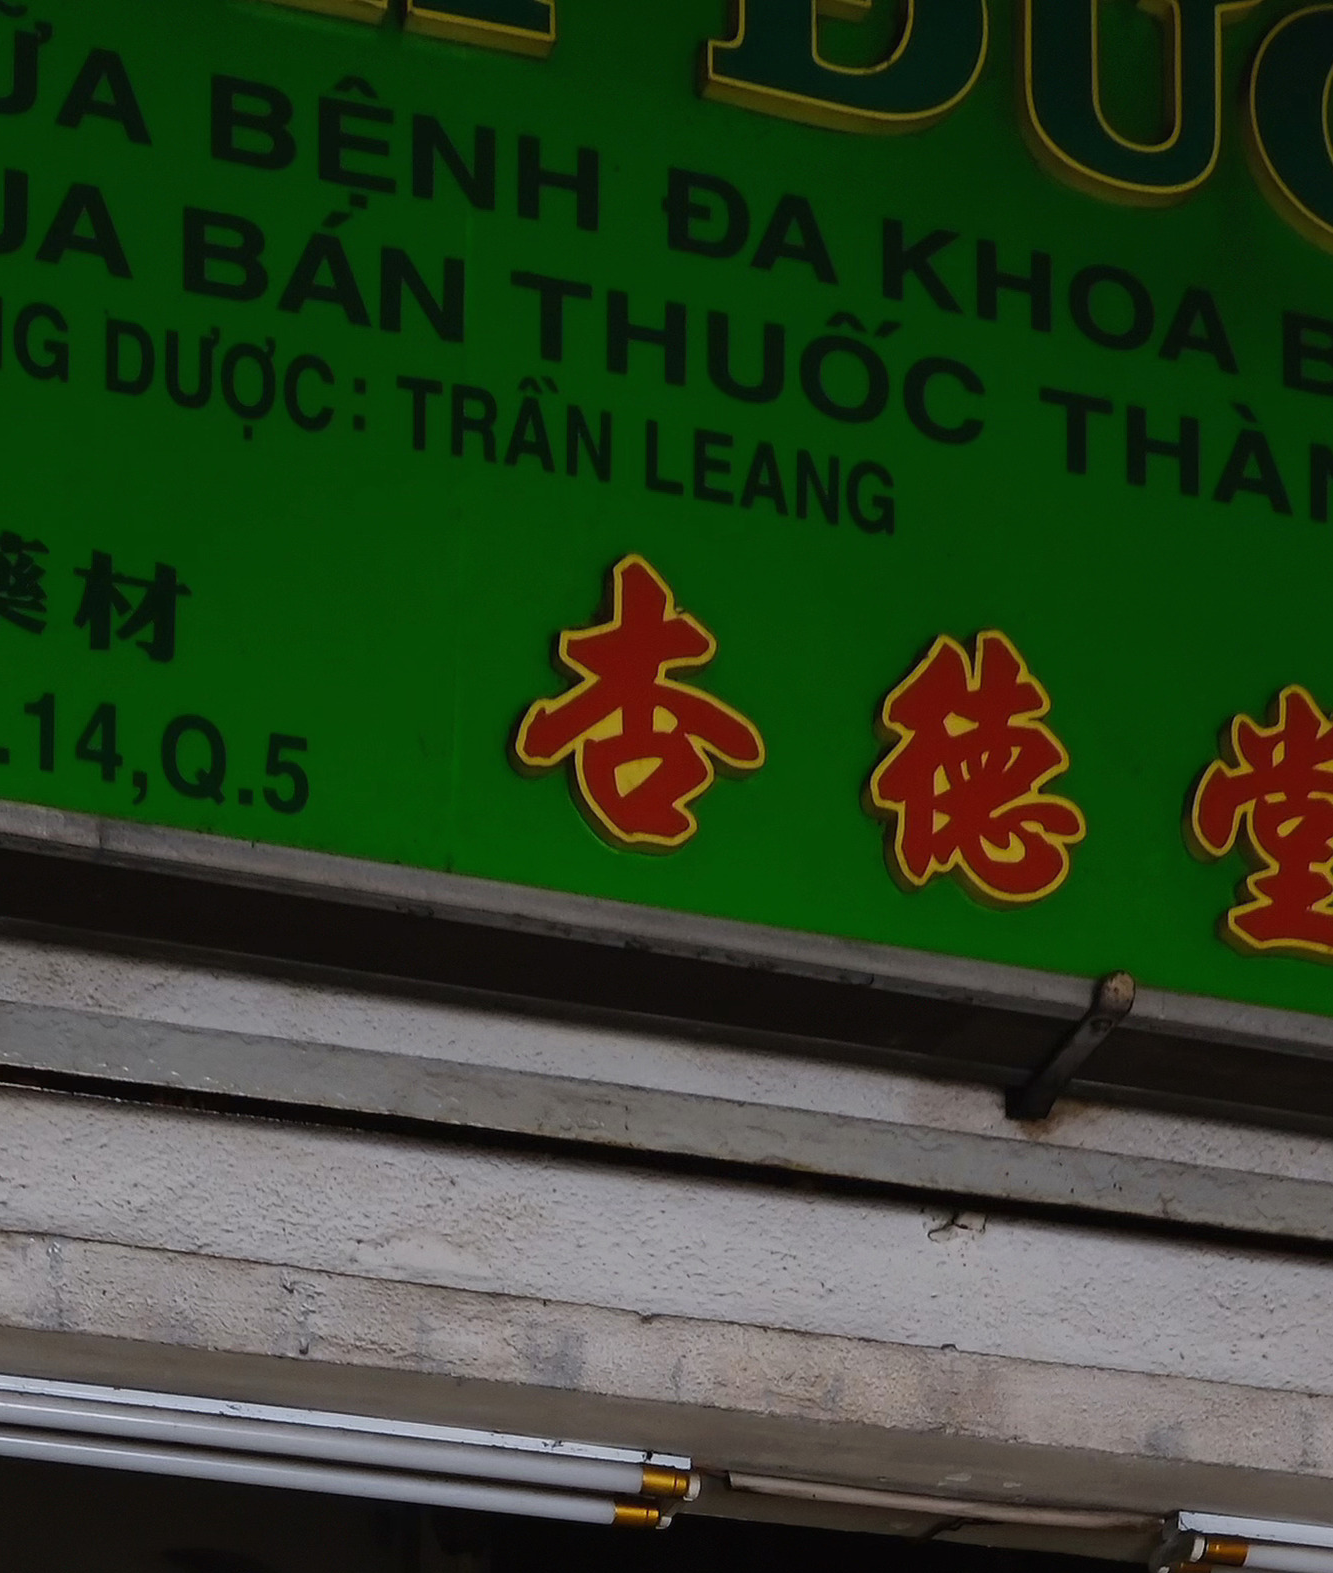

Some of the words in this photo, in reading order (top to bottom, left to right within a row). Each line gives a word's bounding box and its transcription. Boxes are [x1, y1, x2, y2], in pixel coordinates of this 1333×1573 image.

[181, 203, 465, 343] BÁN
[509, 268, 986, 447] THUỐC
[208, 72, 600, 232] BỆNH
[661, 167, 839, 284] ĐA
[880, 216, 1241, 376] KHOA
[397, 370, 613, 483] TRẦN
[644, 417, 897, 536] LEANG
